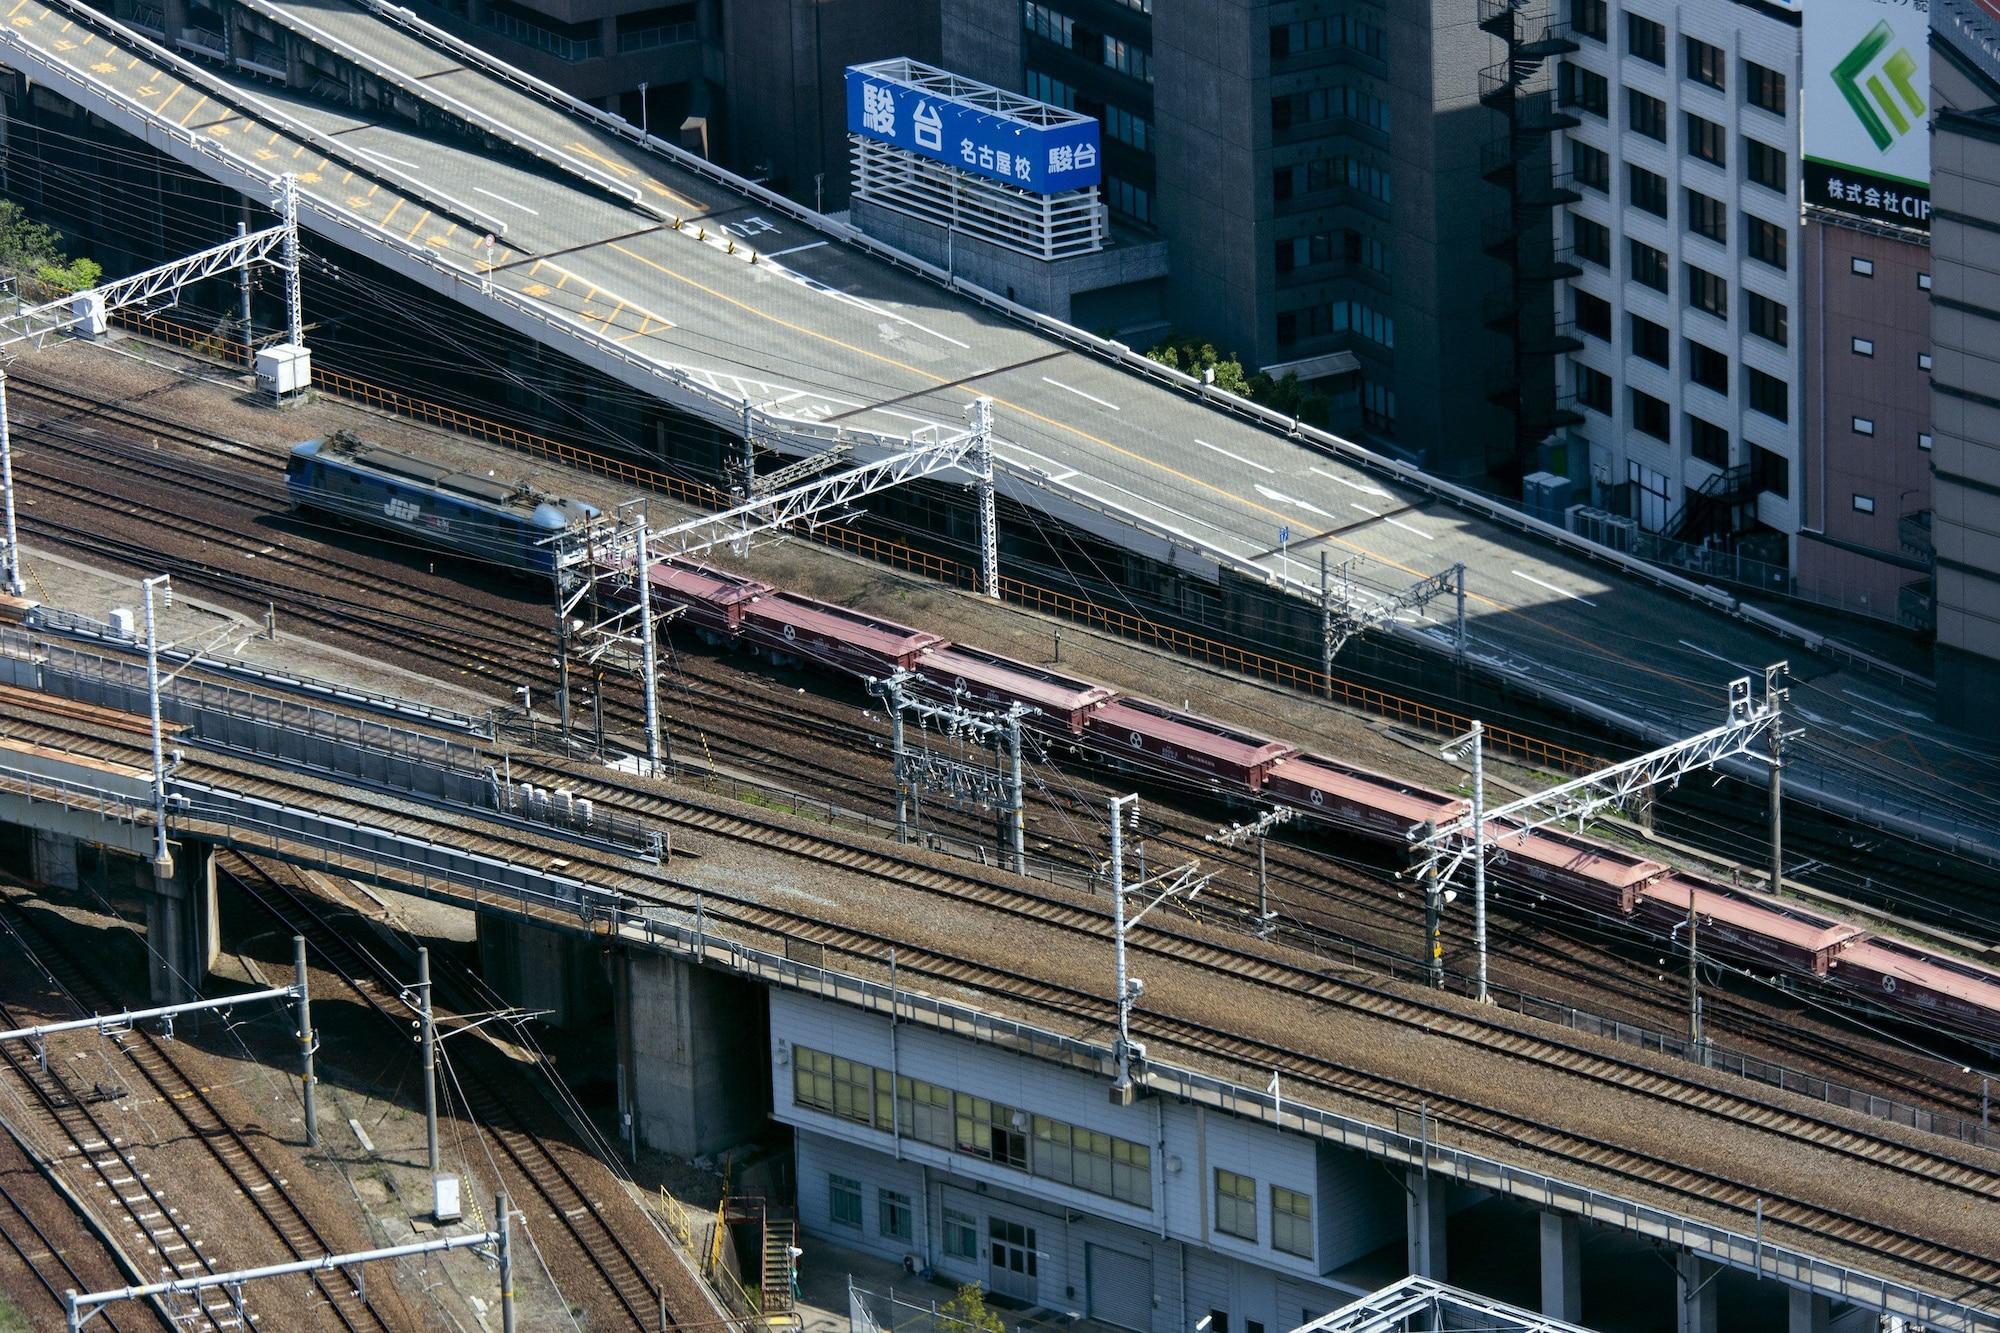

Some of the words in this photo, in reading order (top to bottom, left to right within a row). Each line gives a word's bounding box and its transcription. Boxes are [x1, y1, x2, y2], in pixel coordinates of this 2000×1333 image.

[862, 82, 943, 151] 駿台
[960, 138, 1031, 182] 名古屋校
[1048, 143, 1097, 174] 駿台
[383, 497, 420, 522] JRF
